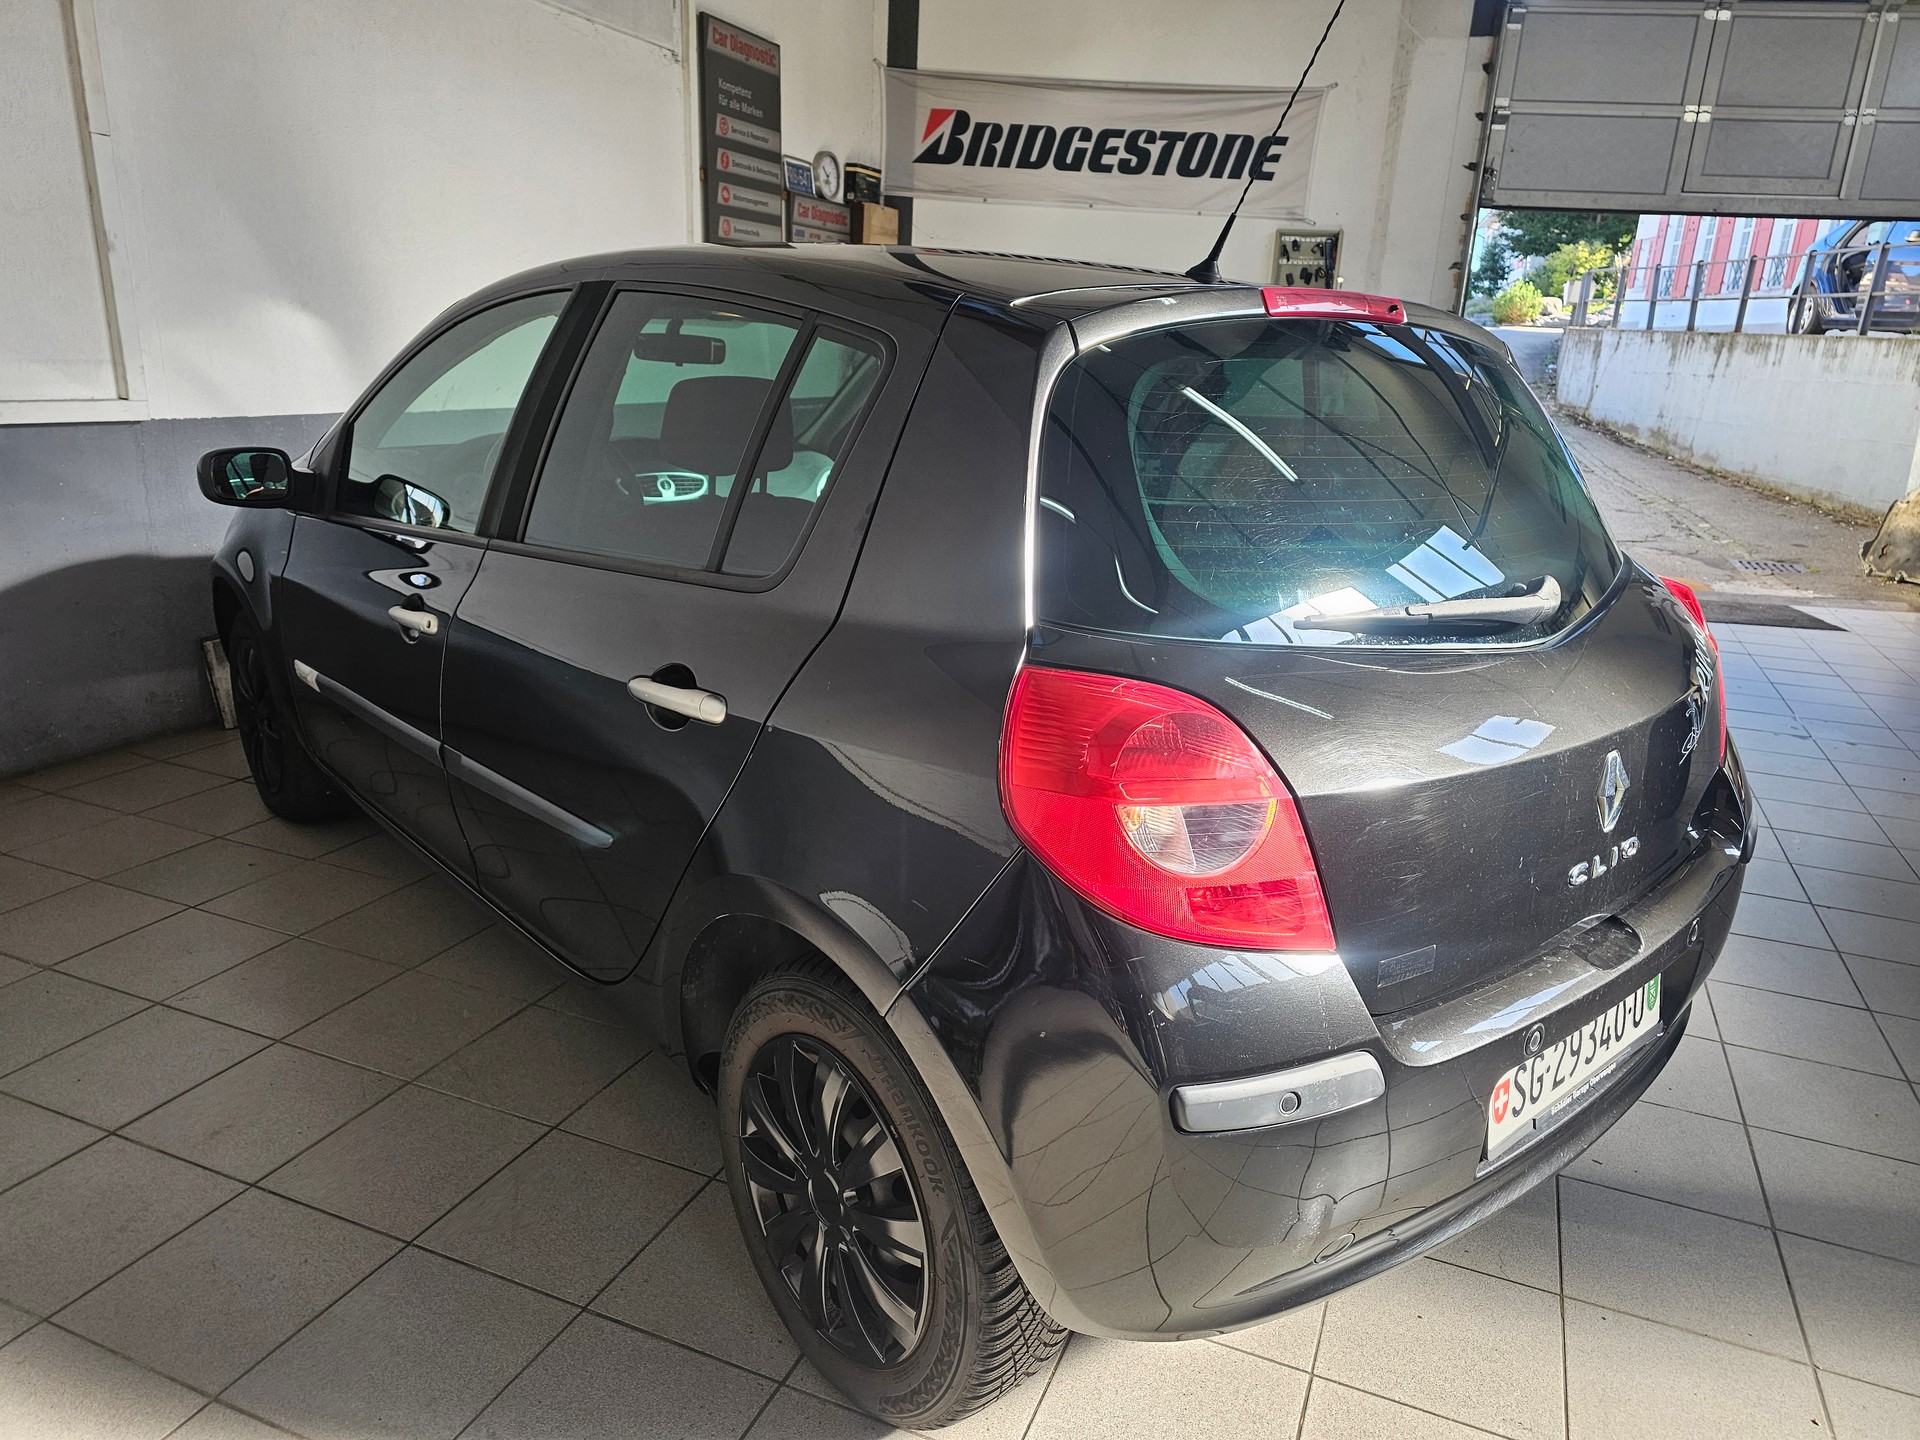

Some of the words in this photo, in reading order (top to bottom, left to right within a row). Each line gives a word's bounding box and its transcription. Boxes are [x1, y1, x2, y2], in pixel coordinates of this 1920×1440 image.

[712, 26, 728, 49] Car
[730, 32, 777, 68] Diagnostic
[718, 77, 752, 99] Kompetenz
[741, 101, 764, 118] Marken
[912, 108, 1289, 181] BRIDGESTONE
[797, 202, 810, 218] Car
[811, 204, 848, 227] Diagnostic
[1567, 836, 1640, 888] CLIO
